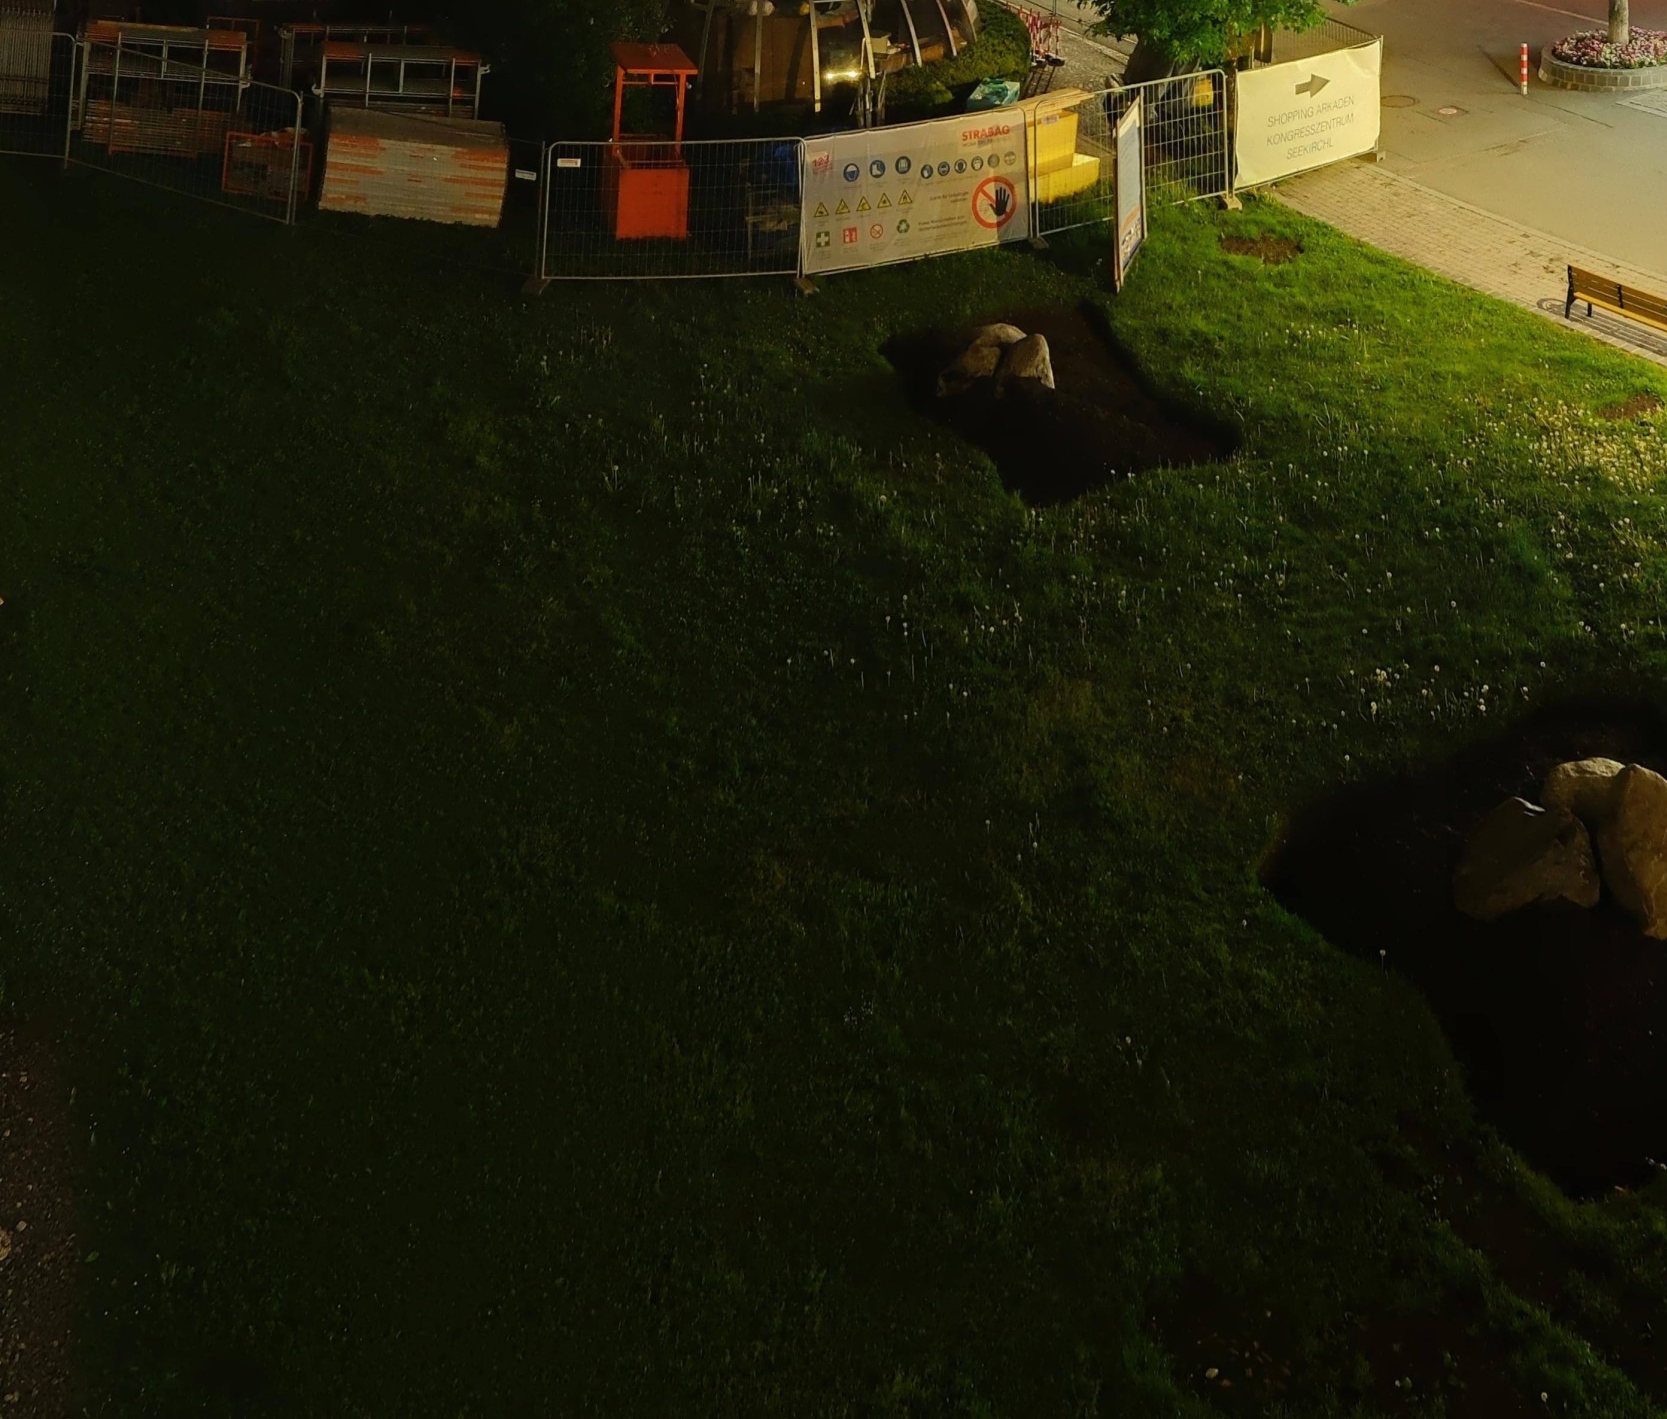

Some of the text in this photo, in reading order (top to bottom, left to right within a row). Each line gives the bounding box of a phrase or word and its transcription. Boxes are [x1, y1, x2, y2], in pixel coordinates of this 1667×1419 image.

[1267, 95, 1355, 128] SHOPPING ARKADEN
[962, 125, 1010, 142] STRABAG
[1266, 112, 1354, 146] KONGRESSZENTRUM
